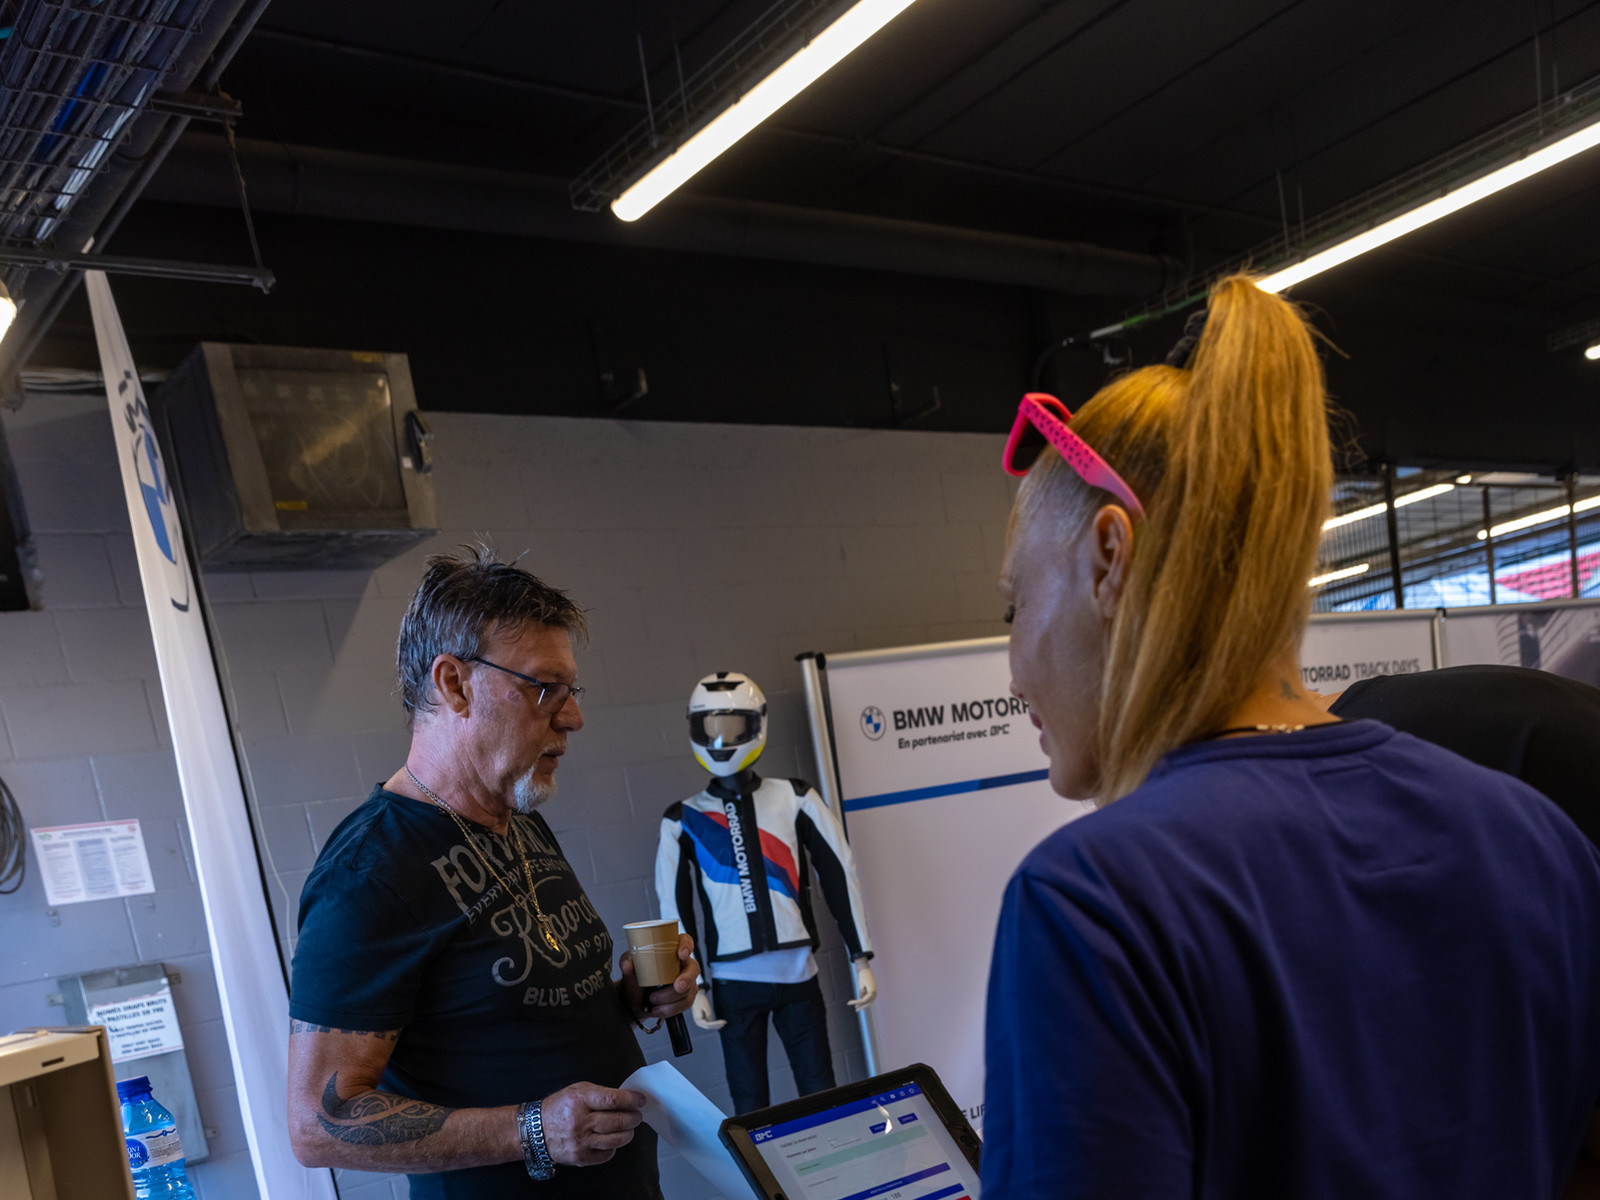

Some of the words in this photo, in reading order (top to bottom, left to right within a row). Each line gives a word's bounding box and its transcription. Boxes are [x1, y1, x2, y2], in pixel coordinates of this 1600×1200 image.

[1302, 664, 1350, 682] TORRAD
[1353, 661, 1392, 678] TRACK
[893, 705, 945, 731] BMW
[951, 697, 1031, 723] MOTOR
[898, 738, 911, 750] En
[911, 731, 966, 750] partenariat
[966, 730, 988, 742] avec
[725, 802, 750, 876] MOTORRAD
[740, 878, 757, 913] BMW
[523, 987, 570, 1007] BLUE
[574, 970, 604, 999] CORE
